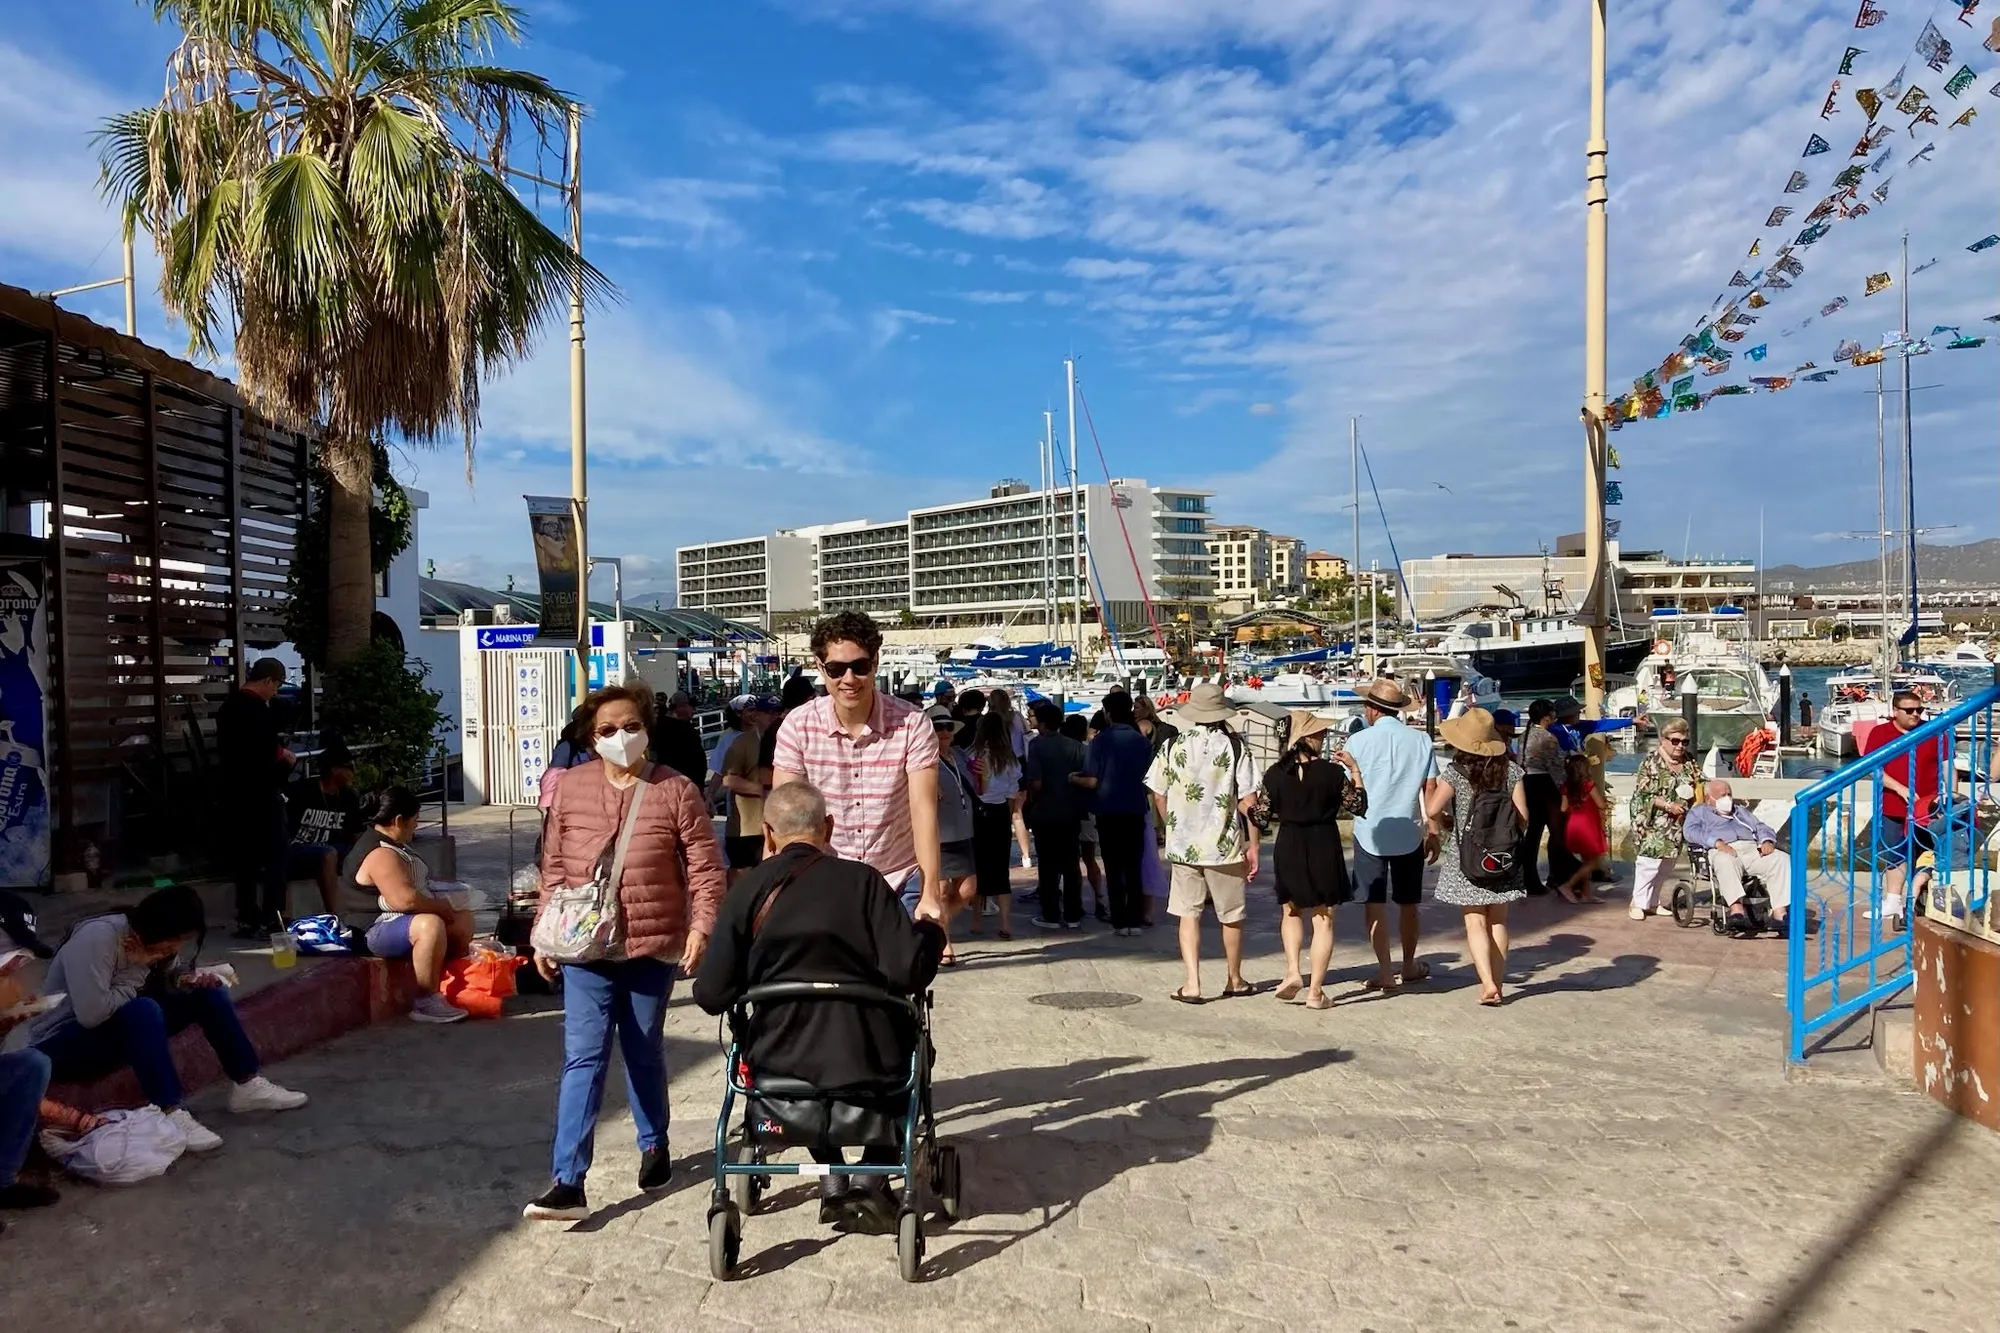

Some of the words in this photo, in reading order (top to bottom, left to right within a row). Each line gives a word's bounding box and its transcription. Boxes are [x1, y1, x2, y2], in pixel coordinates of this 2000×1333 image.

[0, 598, 37, 610] orona
[544, 591, 579, 605] SKYBAR
[495, 633, 522, 643] MARINA
